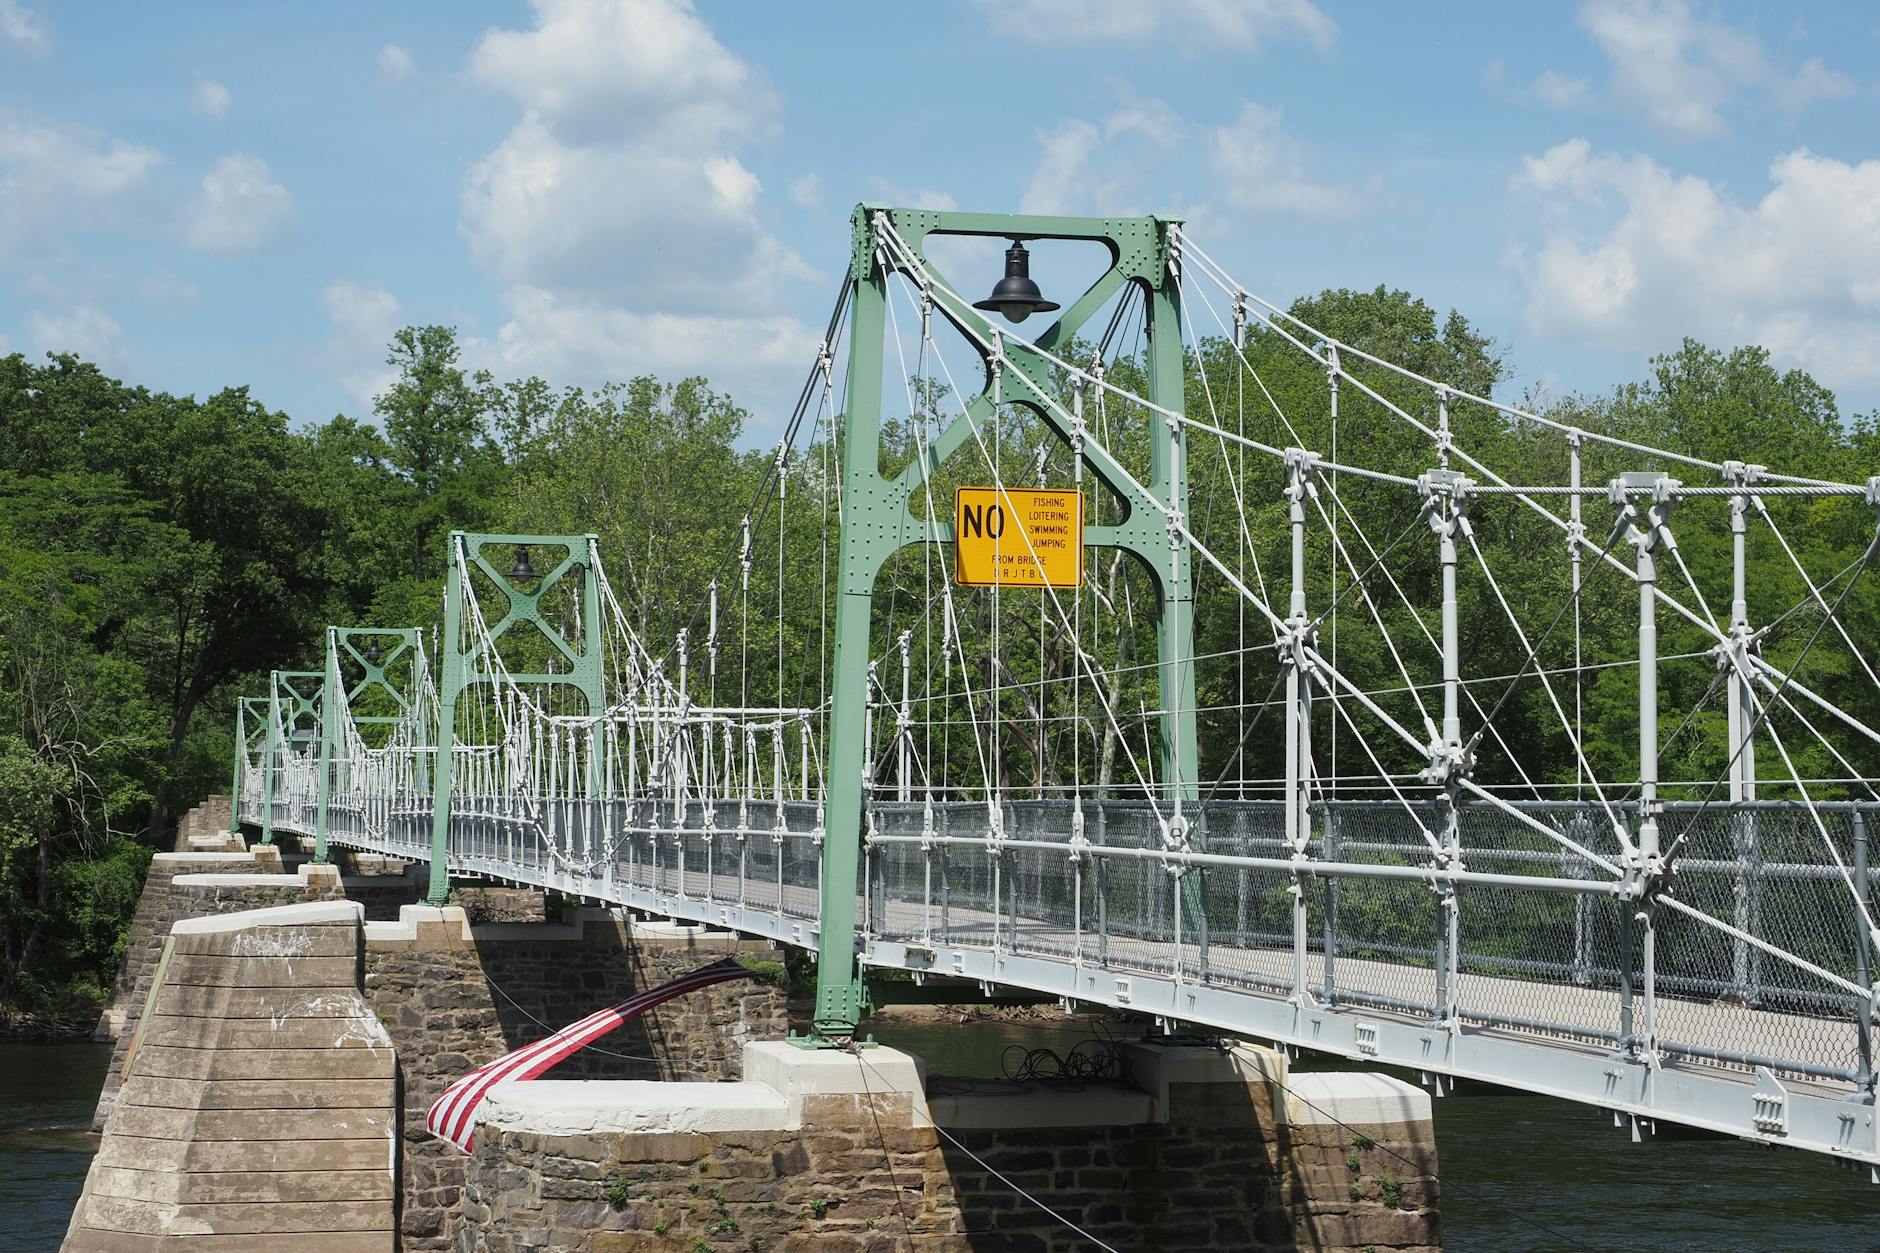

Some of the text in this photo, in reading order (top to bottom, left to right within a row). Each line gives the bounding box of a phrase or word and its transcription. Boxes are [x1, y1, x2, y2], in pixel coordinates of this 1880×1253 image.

[1033, 497, 1065, 507] FISHING
[1029, 511, 1069, 521] LOITERING
[963, 504, 1005, 539] NO
[1029, 525, 1068, 535] SWIMMING
[1031, 538, 1066, 548] JUMPING
